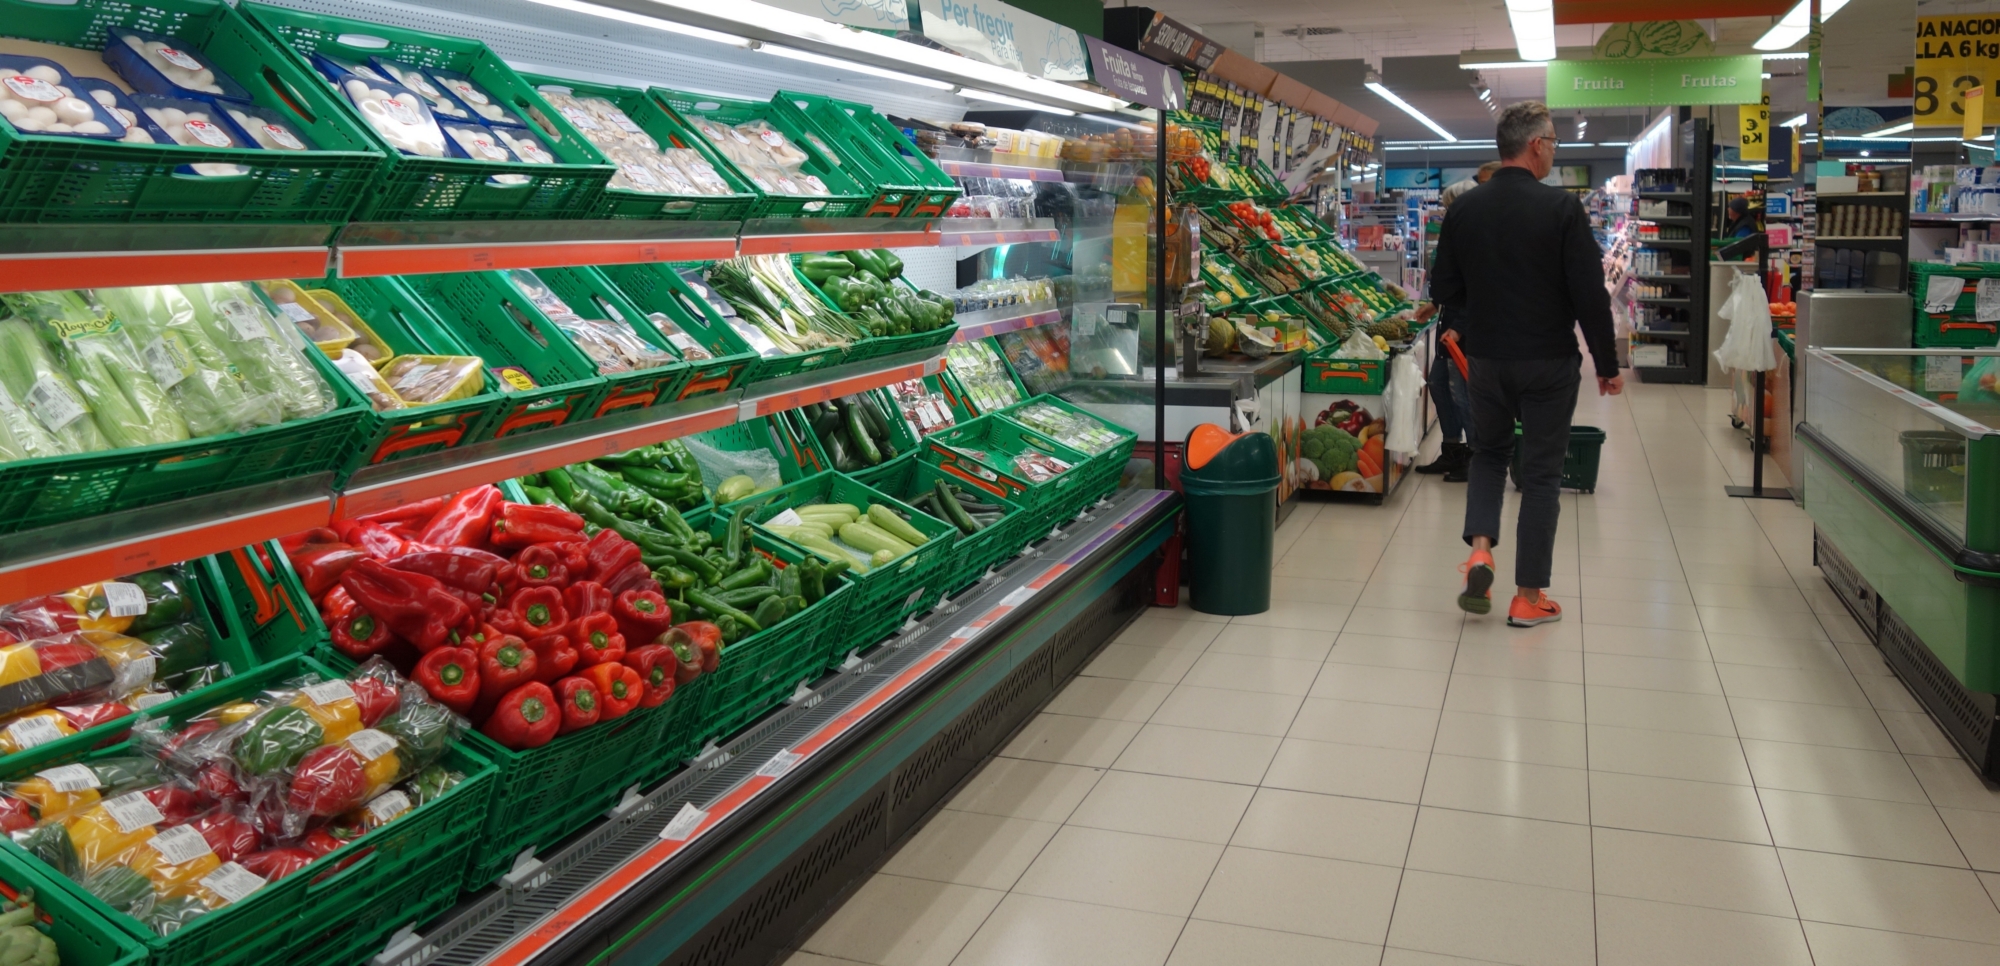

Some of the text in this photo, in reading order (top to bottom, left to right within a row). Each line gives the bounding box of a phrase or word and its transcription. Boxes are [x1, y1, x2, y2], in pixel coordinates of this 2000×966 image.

[941, 0, 1015, 45] Per fregir
[990, 39, 1009, 60] Para
[1959, 39, 1971, 57] 6
[1976, 40, 1999, 59] kg
[1102, 47, 1131, 78] Fruita
[1112, 74, 1148, 95] Fruta de temporada
[1573, 76, 1625, 91] Fruita
[1681, 74, 1738, 89] Frutas
